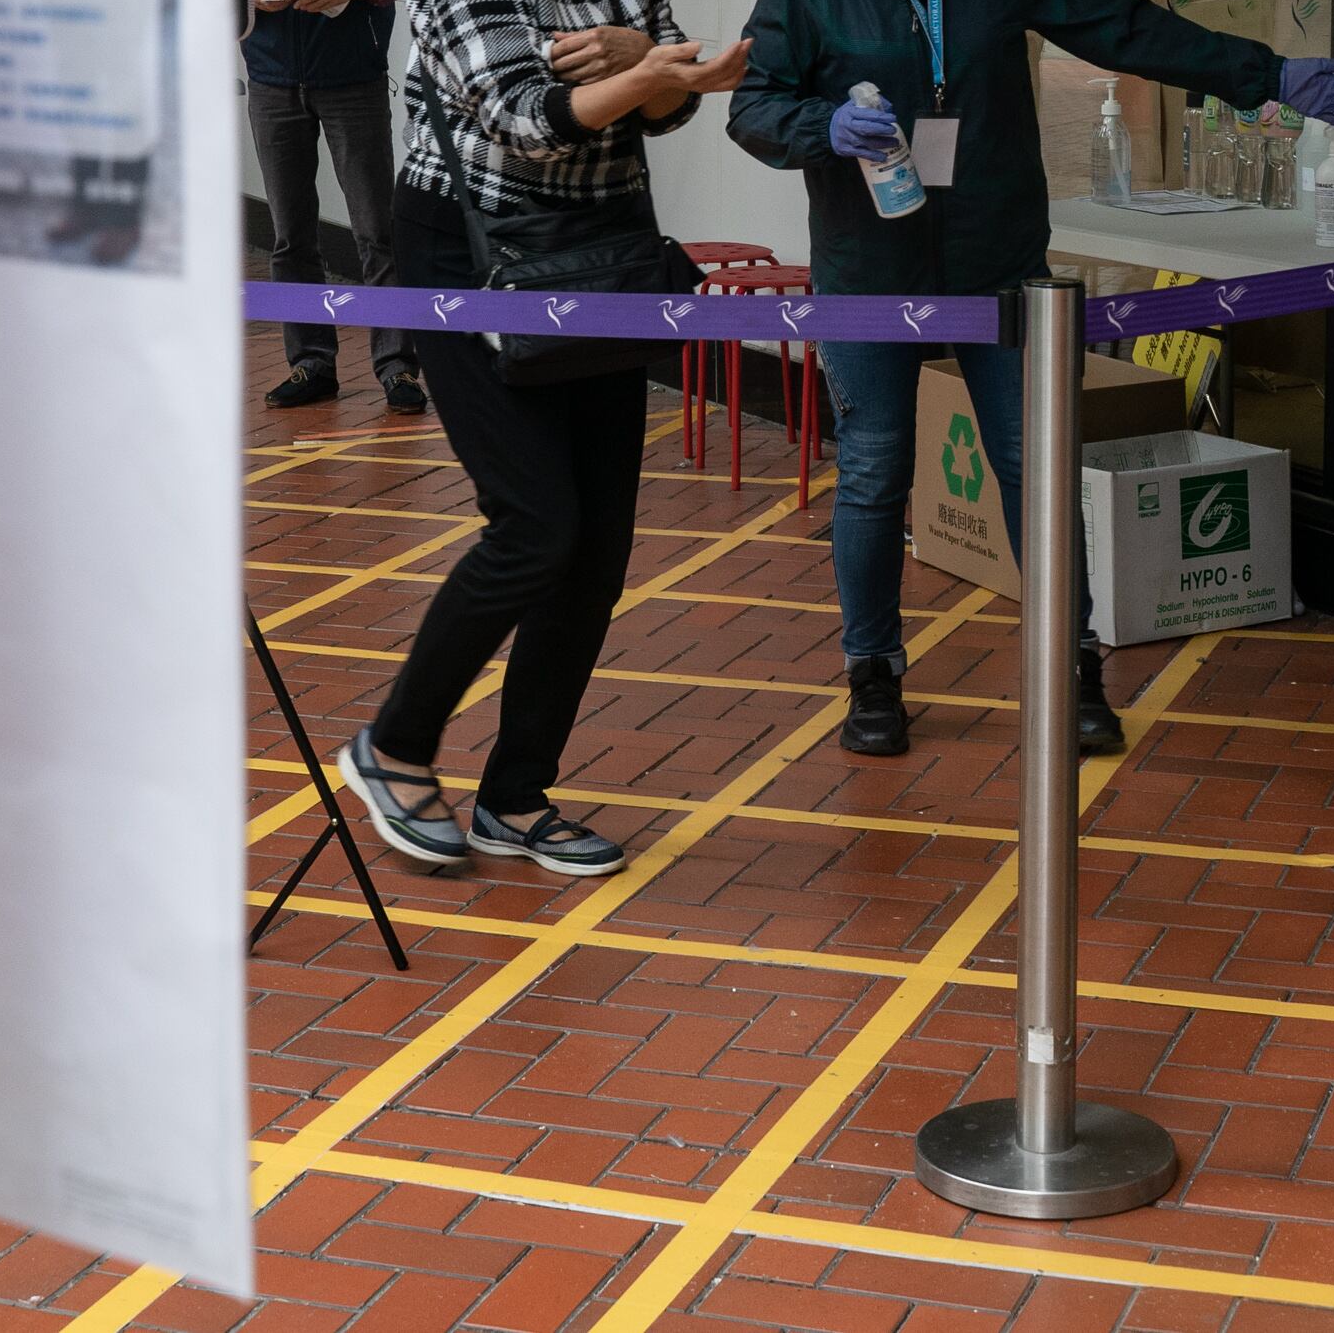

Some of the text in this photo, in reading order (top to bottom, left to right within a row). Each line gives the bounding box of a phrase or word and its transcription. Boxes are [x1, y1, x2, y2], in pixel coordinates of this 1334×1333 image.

[932, 0, 941, 44] ELECTORAL
[938, 503, 987, 540] 廢紙回收箱
[1205, 502, 1234, 521] HYPO
[928, 523, 999, 561] Waste Paper Collection Box
[1180, 567, 1228, 592] HYPO
[1242, 564, 1252, 583] 6
[1154, 600, 1277, 631] (LIQUID BLEACH & DISINFECTANT)
[1156, 587, 1276, 614] Sodium Hypochlorite Solution
